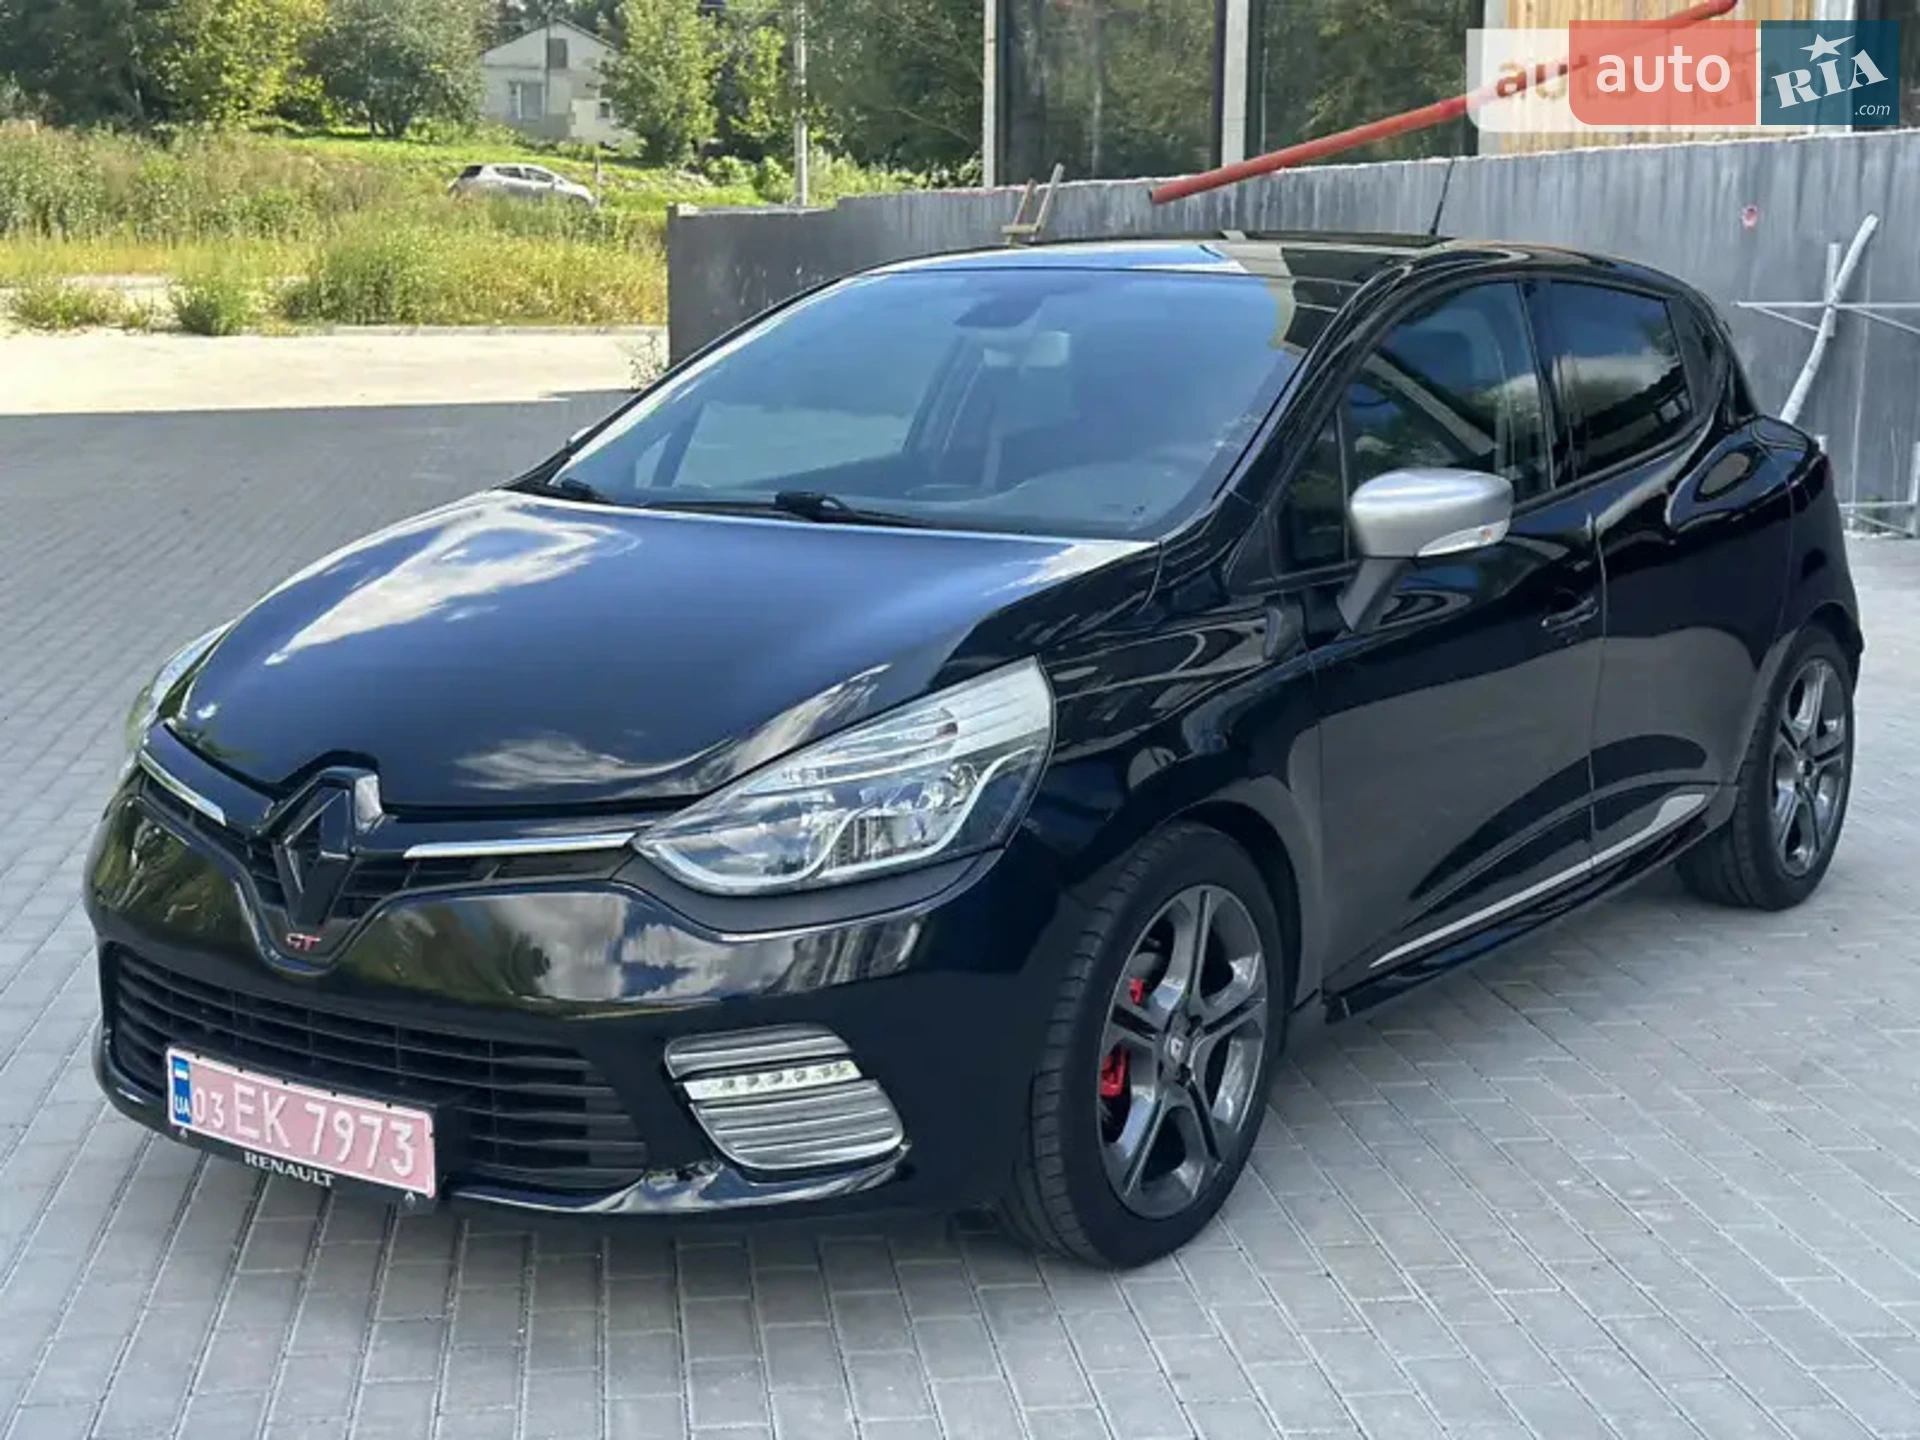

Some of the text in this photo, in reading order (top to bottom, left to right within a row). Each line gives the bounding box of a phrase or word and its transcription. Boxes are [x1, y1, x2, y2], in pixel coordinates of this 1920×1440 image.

[174, 1097, 191, 1116] UA
[193, 1083, 416, 1178] 03 EK 7973
[243, 1151, 335, 1188] RENAULT
